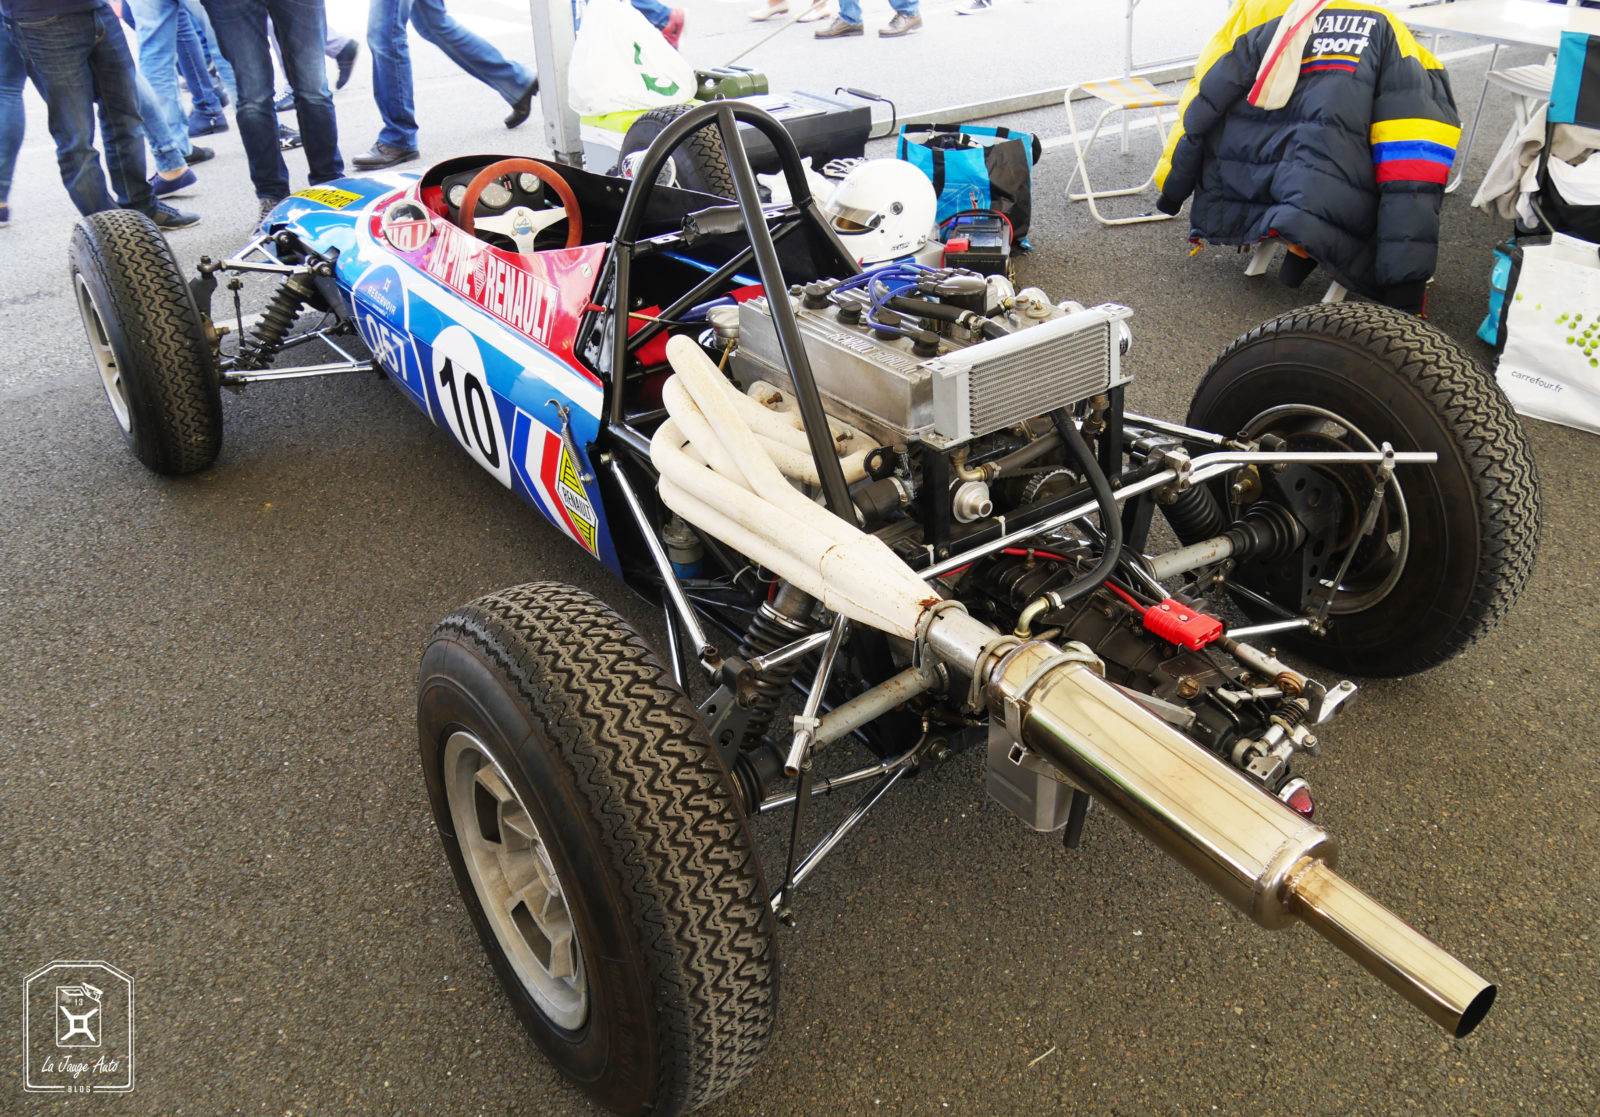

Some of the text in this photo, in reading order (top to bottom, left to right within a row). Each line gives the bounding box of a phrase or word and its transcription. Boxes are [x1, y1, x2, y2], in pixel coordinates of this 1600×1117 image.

[1313, 15, 1376, 36] NAULT
[1312, 36, 1369, 58] sport
[427, 223, 558, 344] ALPINE RENAULT
[1511, 371, 1563, 392] carrefour.fr
[439, 356, 500, 469] 10
[561, 485, 593, 522] RENAULT
